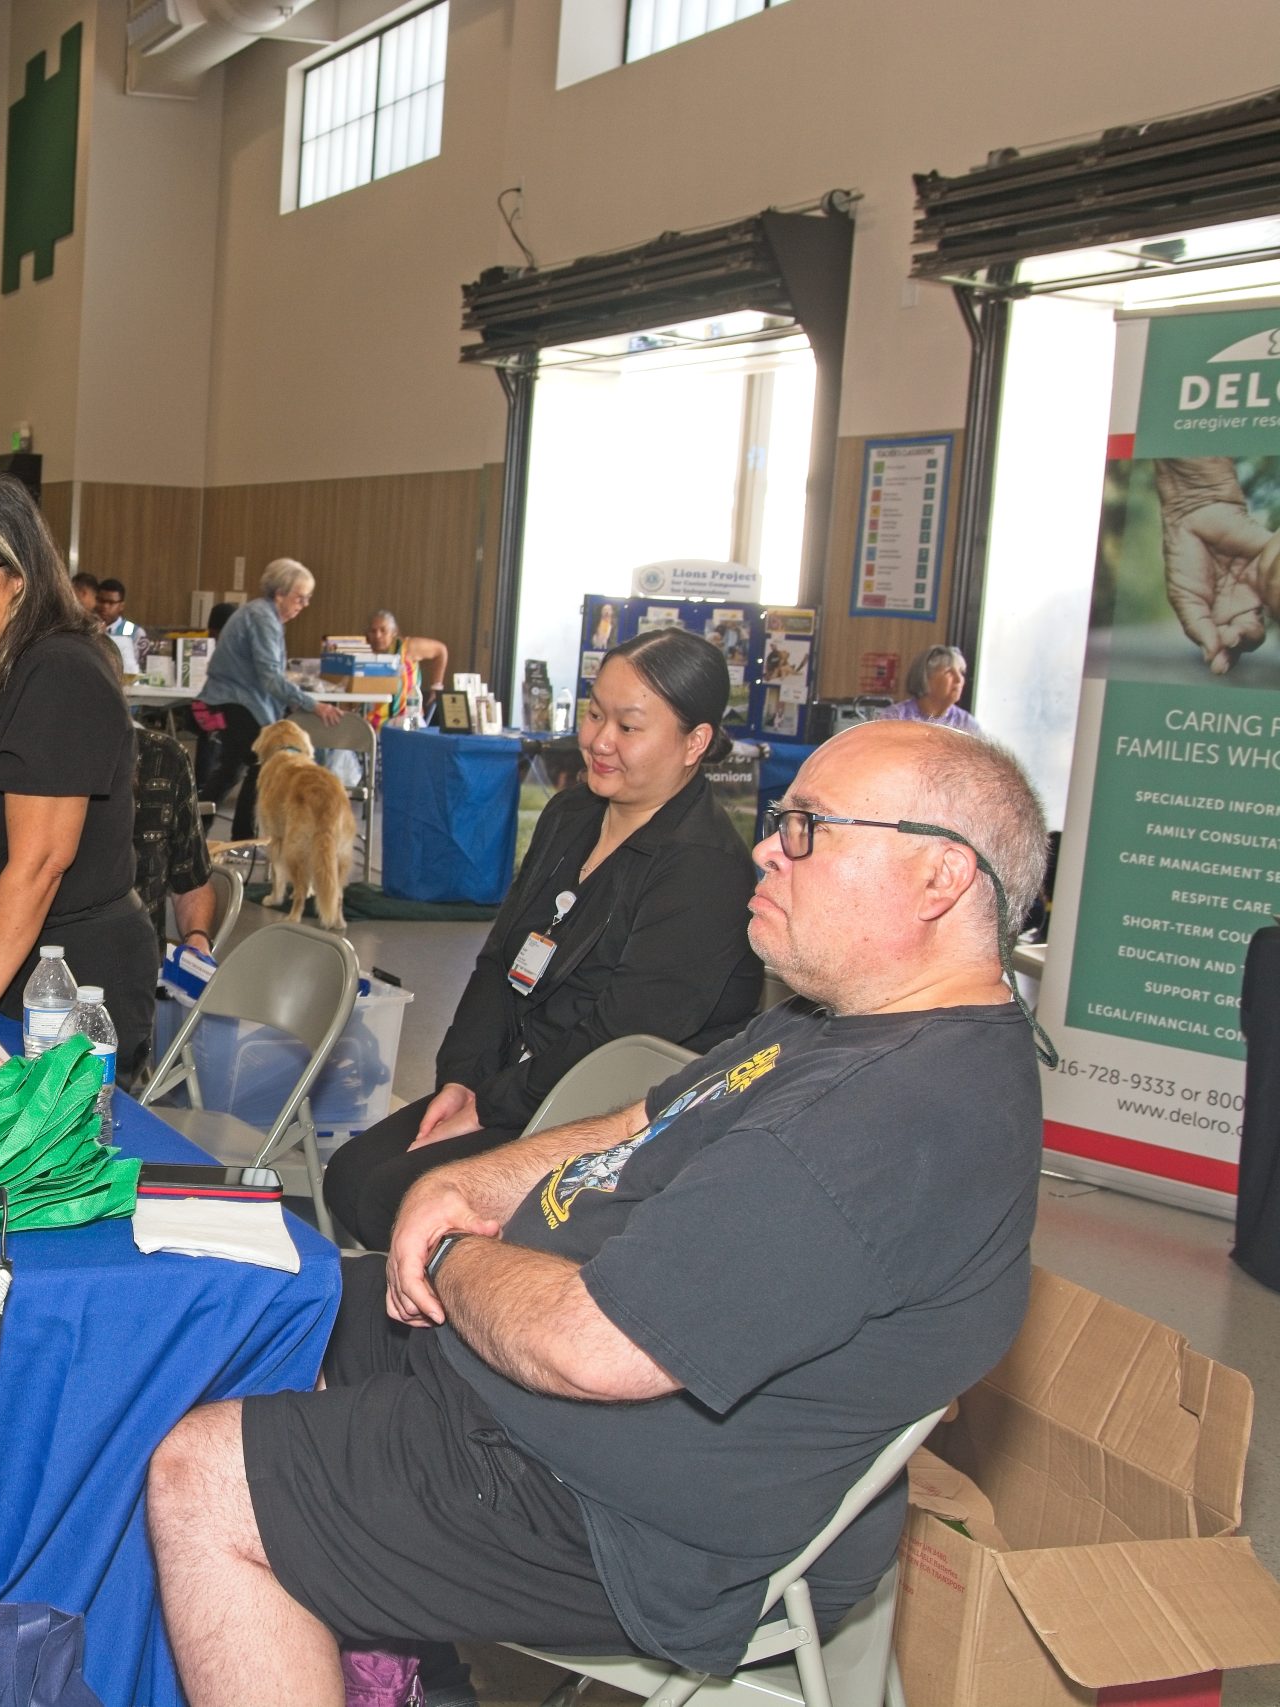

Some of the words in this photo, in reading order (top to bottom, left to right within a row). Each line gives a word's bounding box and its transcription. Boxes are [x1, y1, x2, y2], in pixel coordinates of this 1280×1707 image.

[1178, 371, 1280, 411] DEL
[1173, 415, 1248, 432] caregiver
[1252, 416, 1280, 428] res
[672, 568, 707, 579] Lions
[711, 569, 757, 583] Project
[1165, 709, 1262, 737] CARING
[1116, 736, 1220, 765] FAMILIES
[1135, 791, 1225, 811] SPECIALIZED
[1146, 823, 1196, 840] FAMILY
[1119, 851, 1155, 866] CARE
[1159, 856, 1264, 880] MANAGEMENT
[1171, 890, 1229, 909] RESPITE
[1233, 899, 1273, 915] CARE
[1122, 914, 1214, 939] SHORT-TERM
[1117, 945, 1201, 969] EDUCATION
[1204, 960, 1236, 975] AND
[1144, 981, 1211, 1003] SUPPORT
[1087, 1003, 1211, 1036] LEGAL/FINANCIAL
[1048, 1058, 1176, 1098] 16-728-9333
[1181, 1087, 1202, 1102] or
[546, 1213, 560, 1230] YOU
